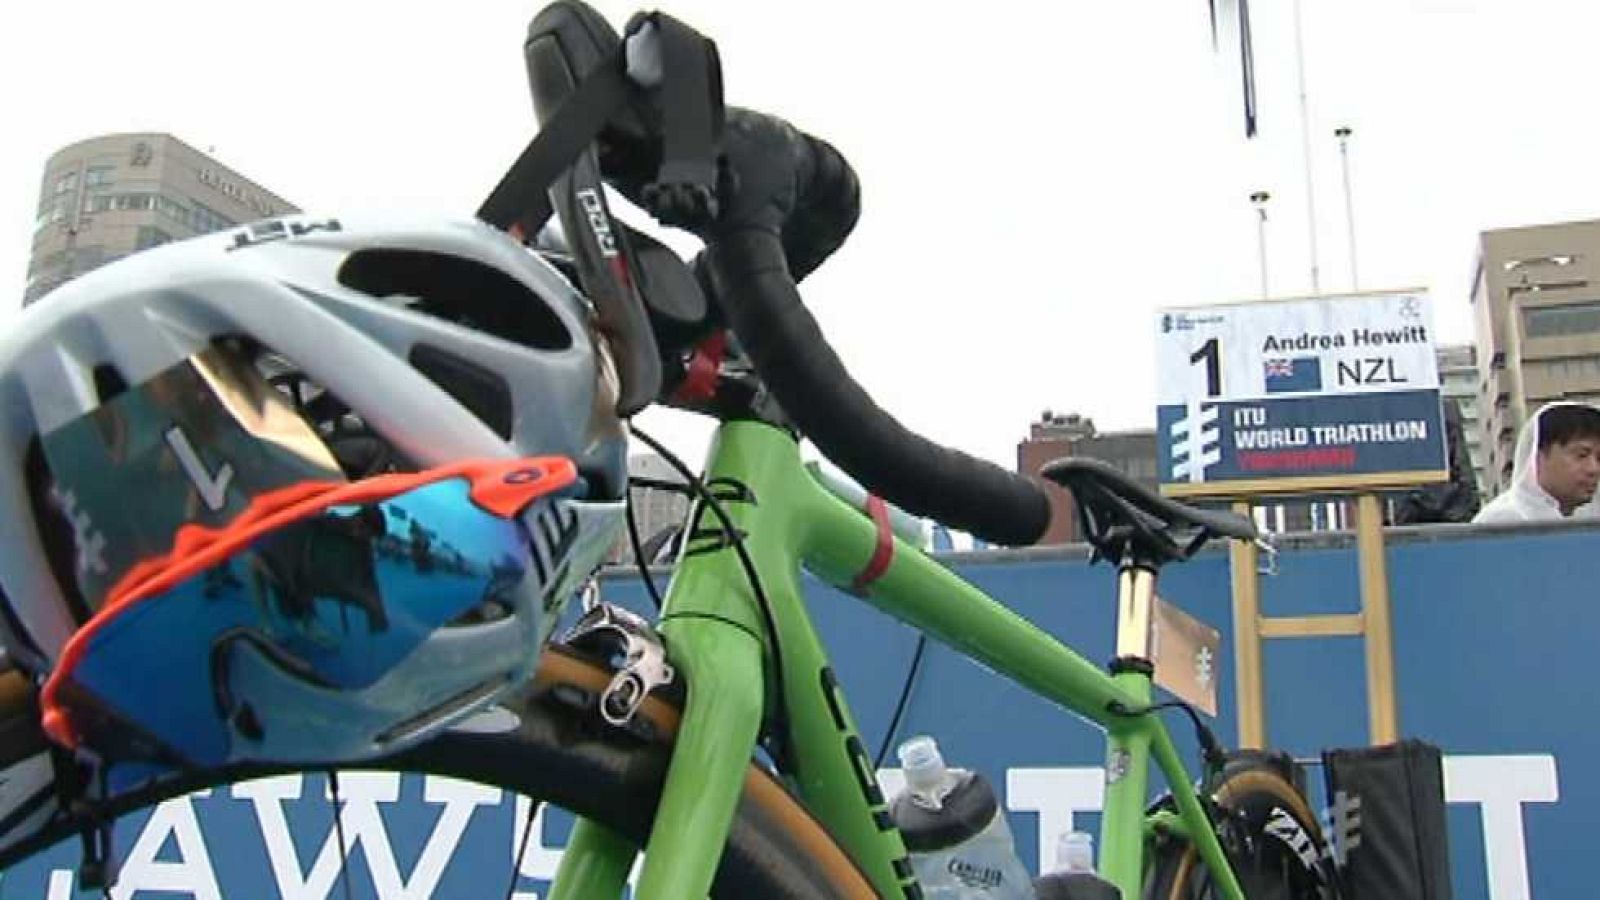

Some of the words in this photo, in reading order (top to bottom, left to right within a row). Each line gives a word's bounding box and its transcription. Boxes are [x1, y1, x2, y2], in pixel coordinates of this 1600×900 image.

[1262, 333, 1346, 353] Andrea
[1352, 325, 1428, 346] Hewitt
[1189, 337, 1222, 396] 1
[1336, 356, 1407, 386] NZL
[1233, 407, 1266, 427] ITU
[1234, 426, 1308, 450] WORLD
[1314, 420, 1427, 445] TRIATHLON
